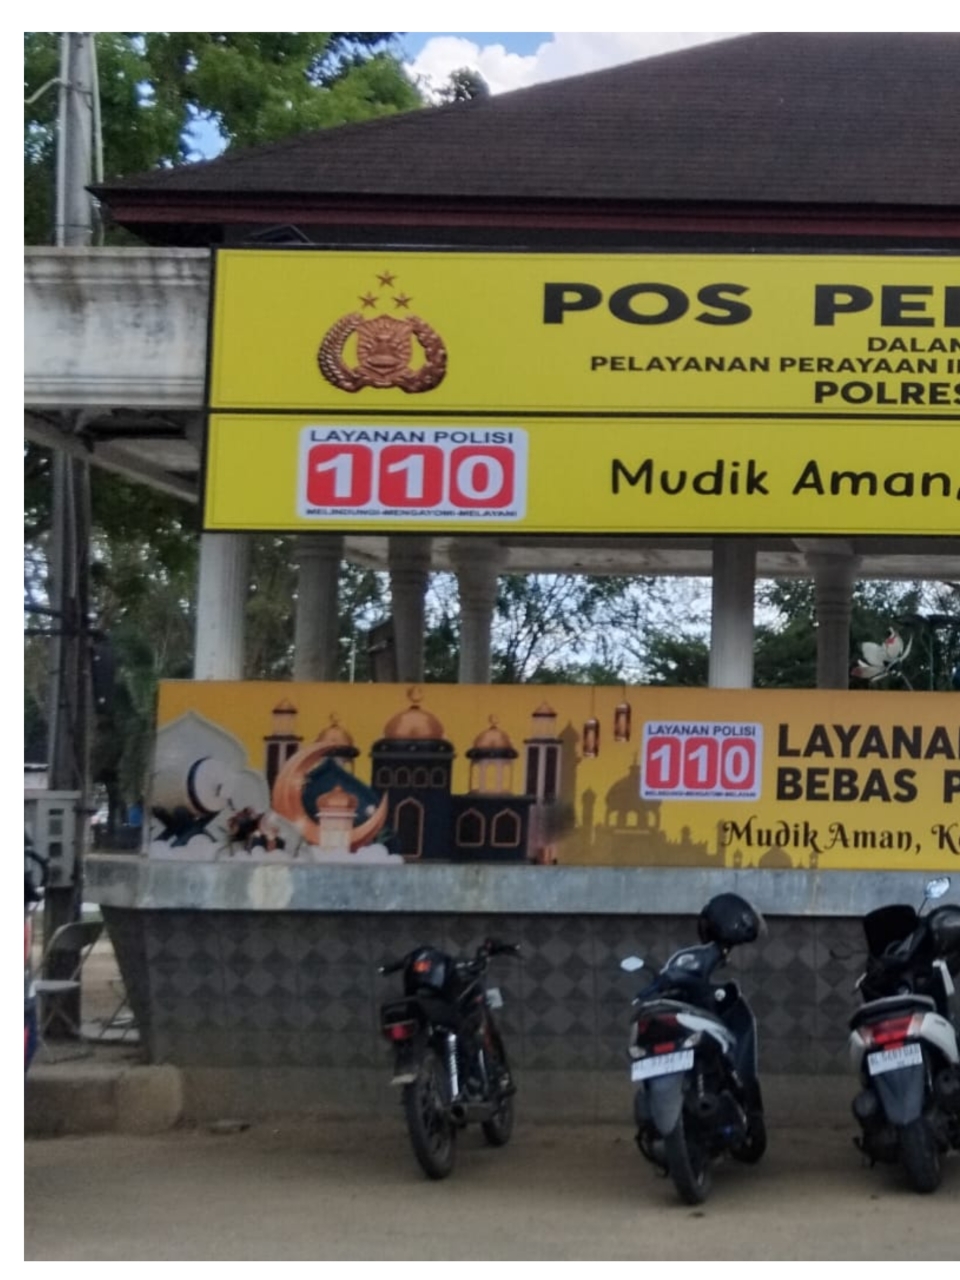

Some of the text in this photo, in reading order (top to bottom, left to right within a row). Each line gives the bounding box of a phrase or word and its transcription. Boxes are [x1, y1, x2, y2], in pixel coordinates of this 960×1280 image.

[542, 282, 753, 326] POS
[590, 355, 770, 373] PELAYANAN
[779, 356, 938, 374] PERAYAAN
[310, 430, 514, 444] LAYANAN POLISI
[315, 453, 504, 500] 110
[611, 458, 770, 496] Mudik
[648, 724, 756, 737] LAYANAN POLISI
[650, 744, 750, 783] 110
[776, 766, 918, 803] BEBAS
[721, 816, 824, 854] Mudik
[826, 822, 921, 854] Aman,
